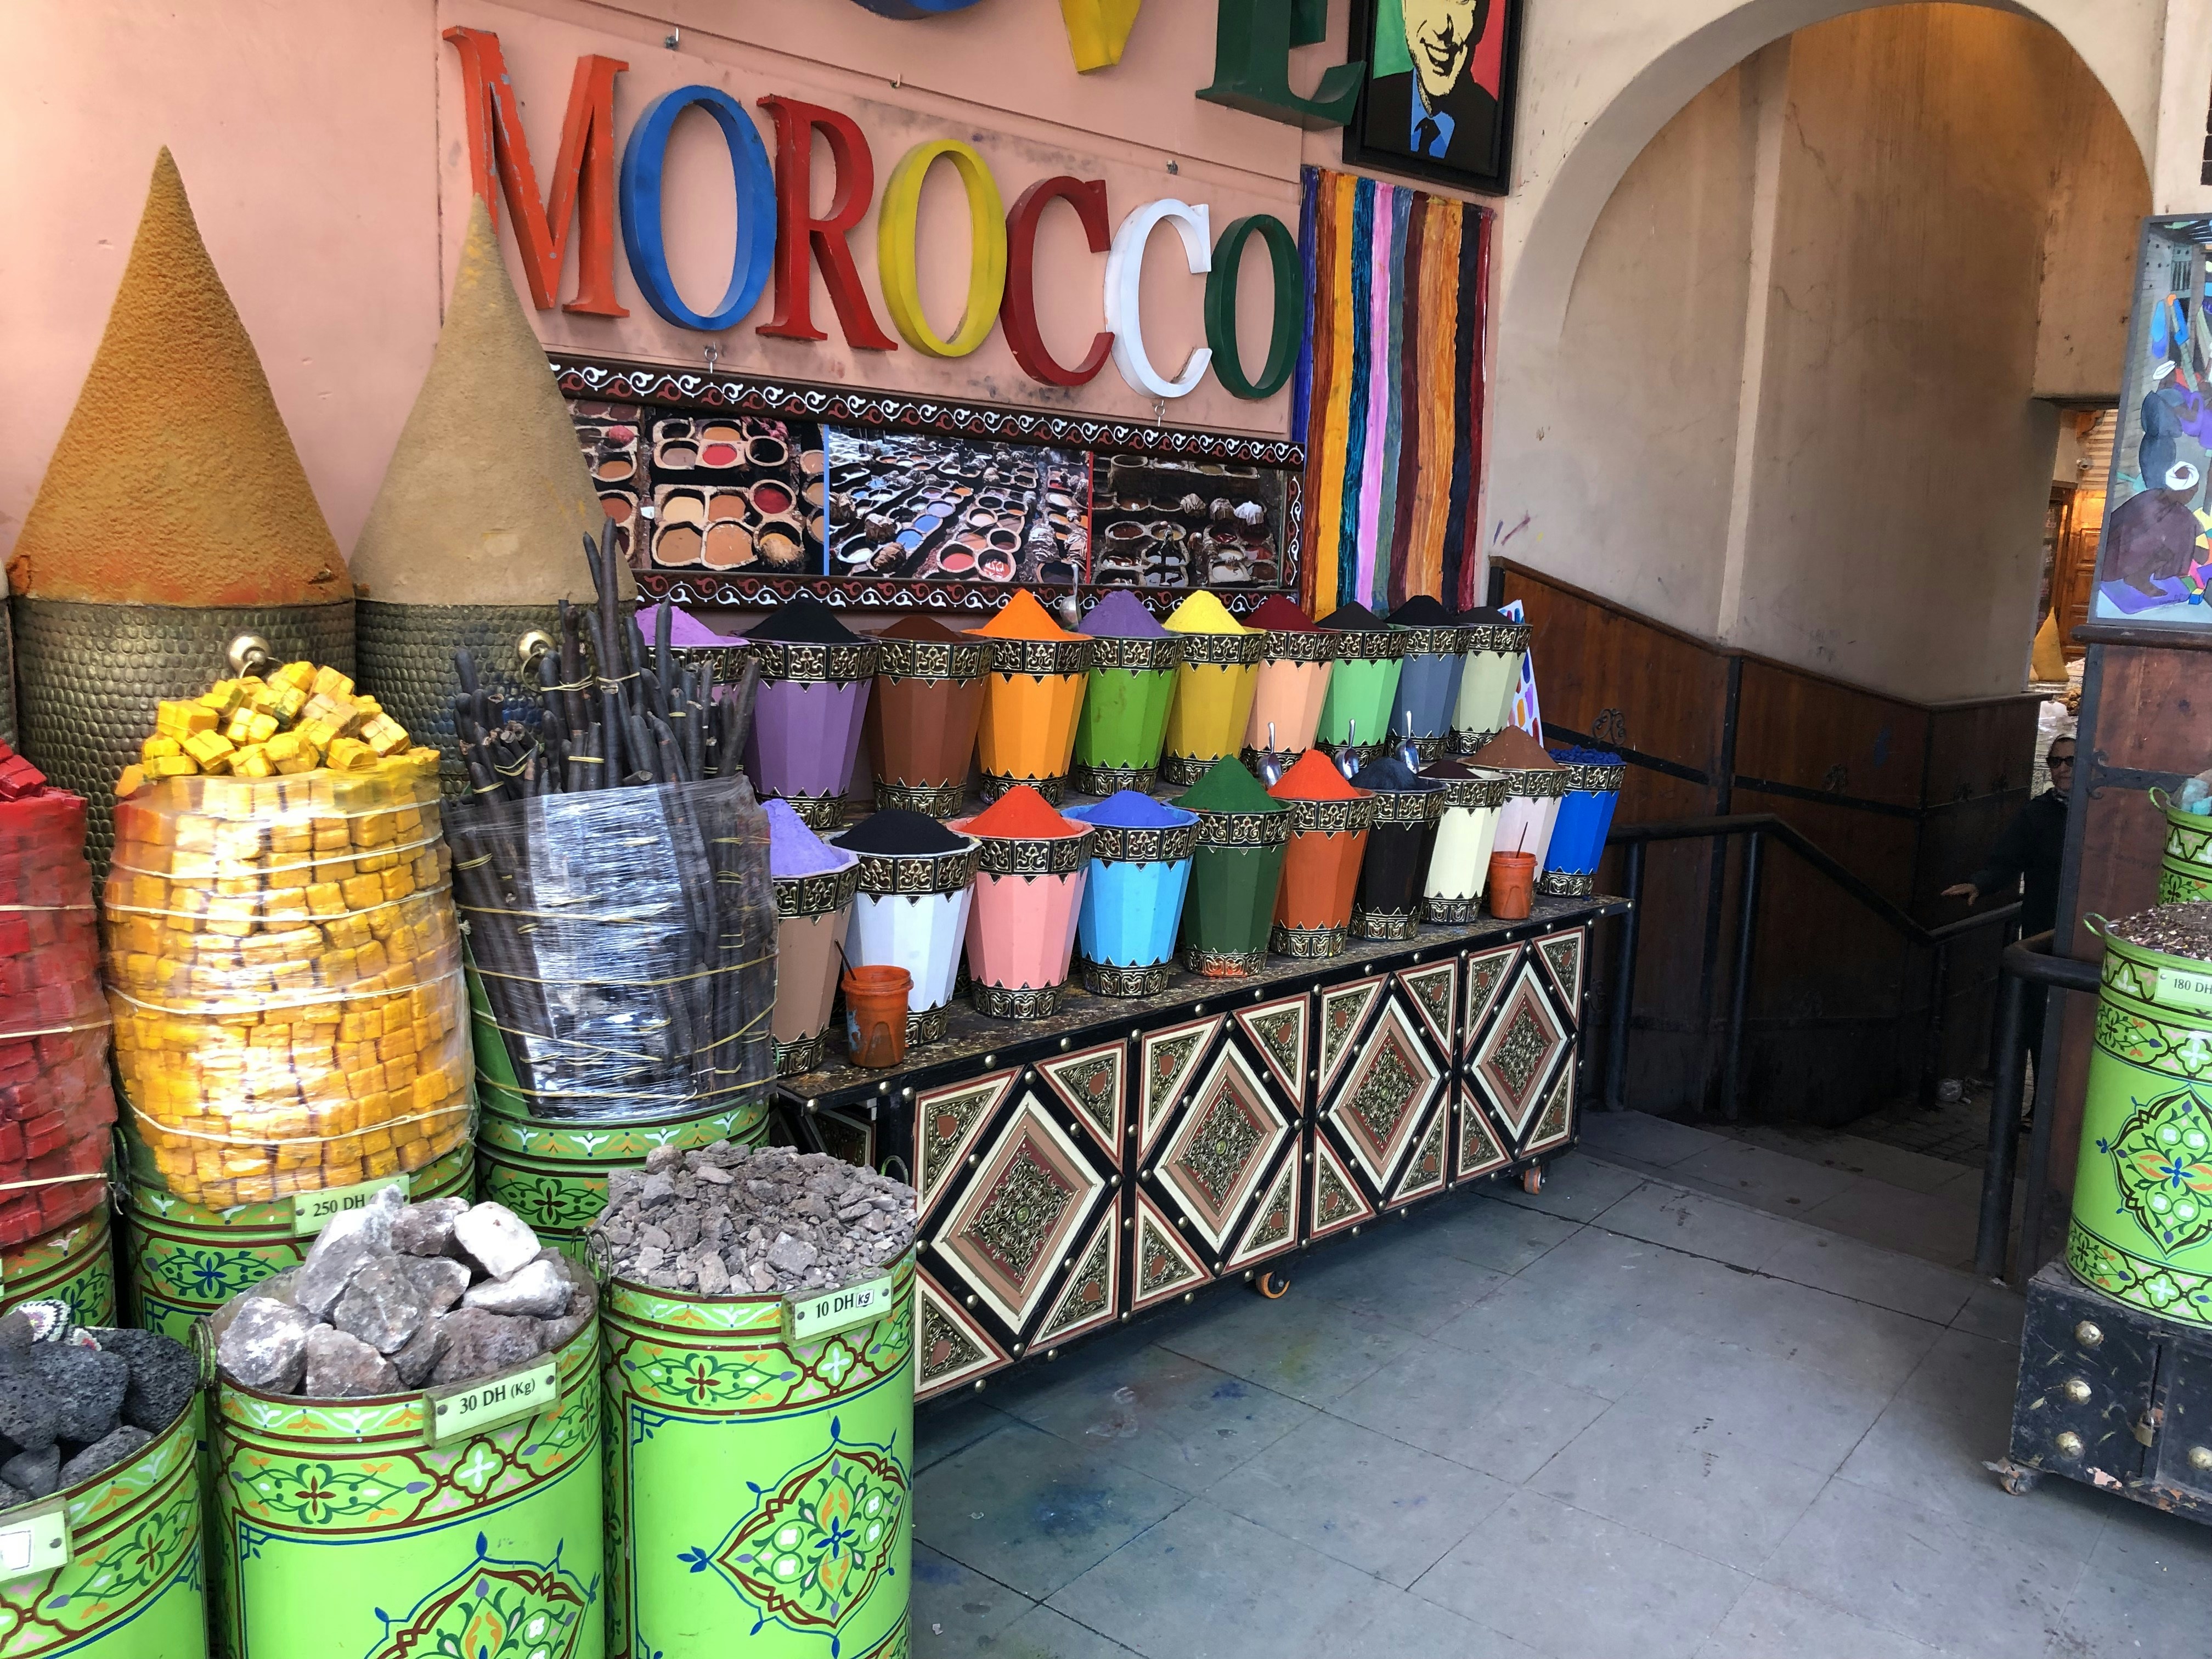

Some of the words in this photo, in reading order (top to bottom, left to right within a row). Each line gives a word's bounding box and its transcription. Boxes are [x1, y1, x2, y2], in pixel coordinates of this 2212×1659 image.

[441, 25, 1304, 398] MOROCCO
[2174, 978, 2191, 991] 180
[2194, 982, 2212, 995] DH
[313, 1199, 338, 1217] 250
[343, 1194, 365, 1211] DH
[815, 1301, 830, 1318] 10
[834, 1293, 854, 1313] DH
[459, 1395, 478, 1414] 30
[483, 1385, 506, 1407] DH
[511, 1378, 536, 1399] (Kg)
